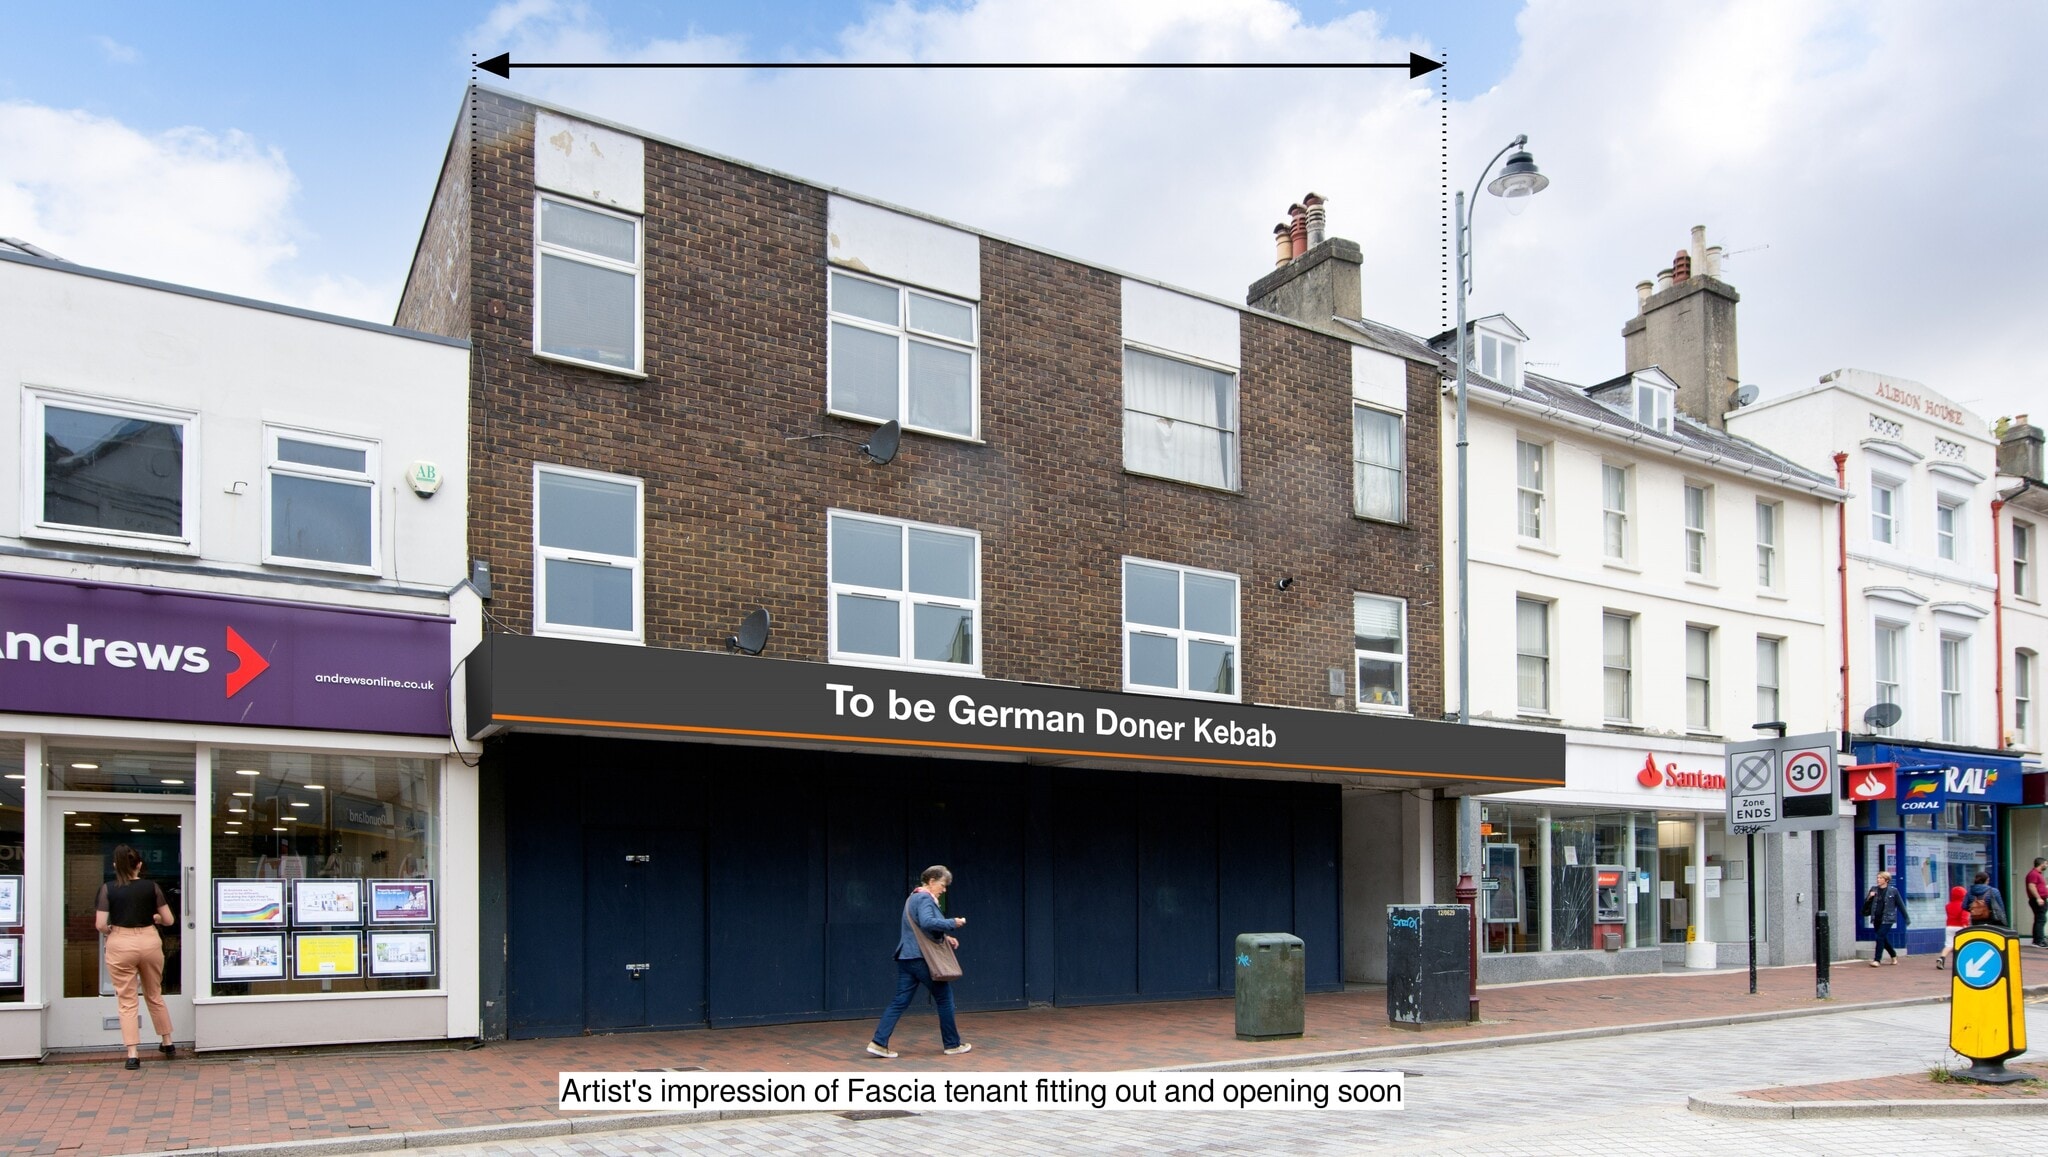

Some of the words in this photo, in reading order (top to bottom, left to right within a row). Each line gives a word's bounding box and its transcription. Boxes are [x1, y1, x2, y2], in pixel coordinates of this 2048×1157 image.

[1875, 382, 1921, 411] ALBION
[416, 465, 436, 479] AB
[0, 624, 210, 673] ndrews
[315, 673, 434, 690] andrewsonline.co.uk
[826, 683, 874, 718] To
[889, 688, 936, 722] be
[948, 694, 1085, 733] German
[1096, 707, 1185, 741] Doner
[1195, 717, 1277, 748] Kebab
[1791, 763, 1822, 782] 30
[1938, 766, 1986, 795] RAL
[1743, 799, 1765, 807] Zone
[1901, 801, 1940, 810] CORAL
[1737, 808, 1771, 819] ENDS
